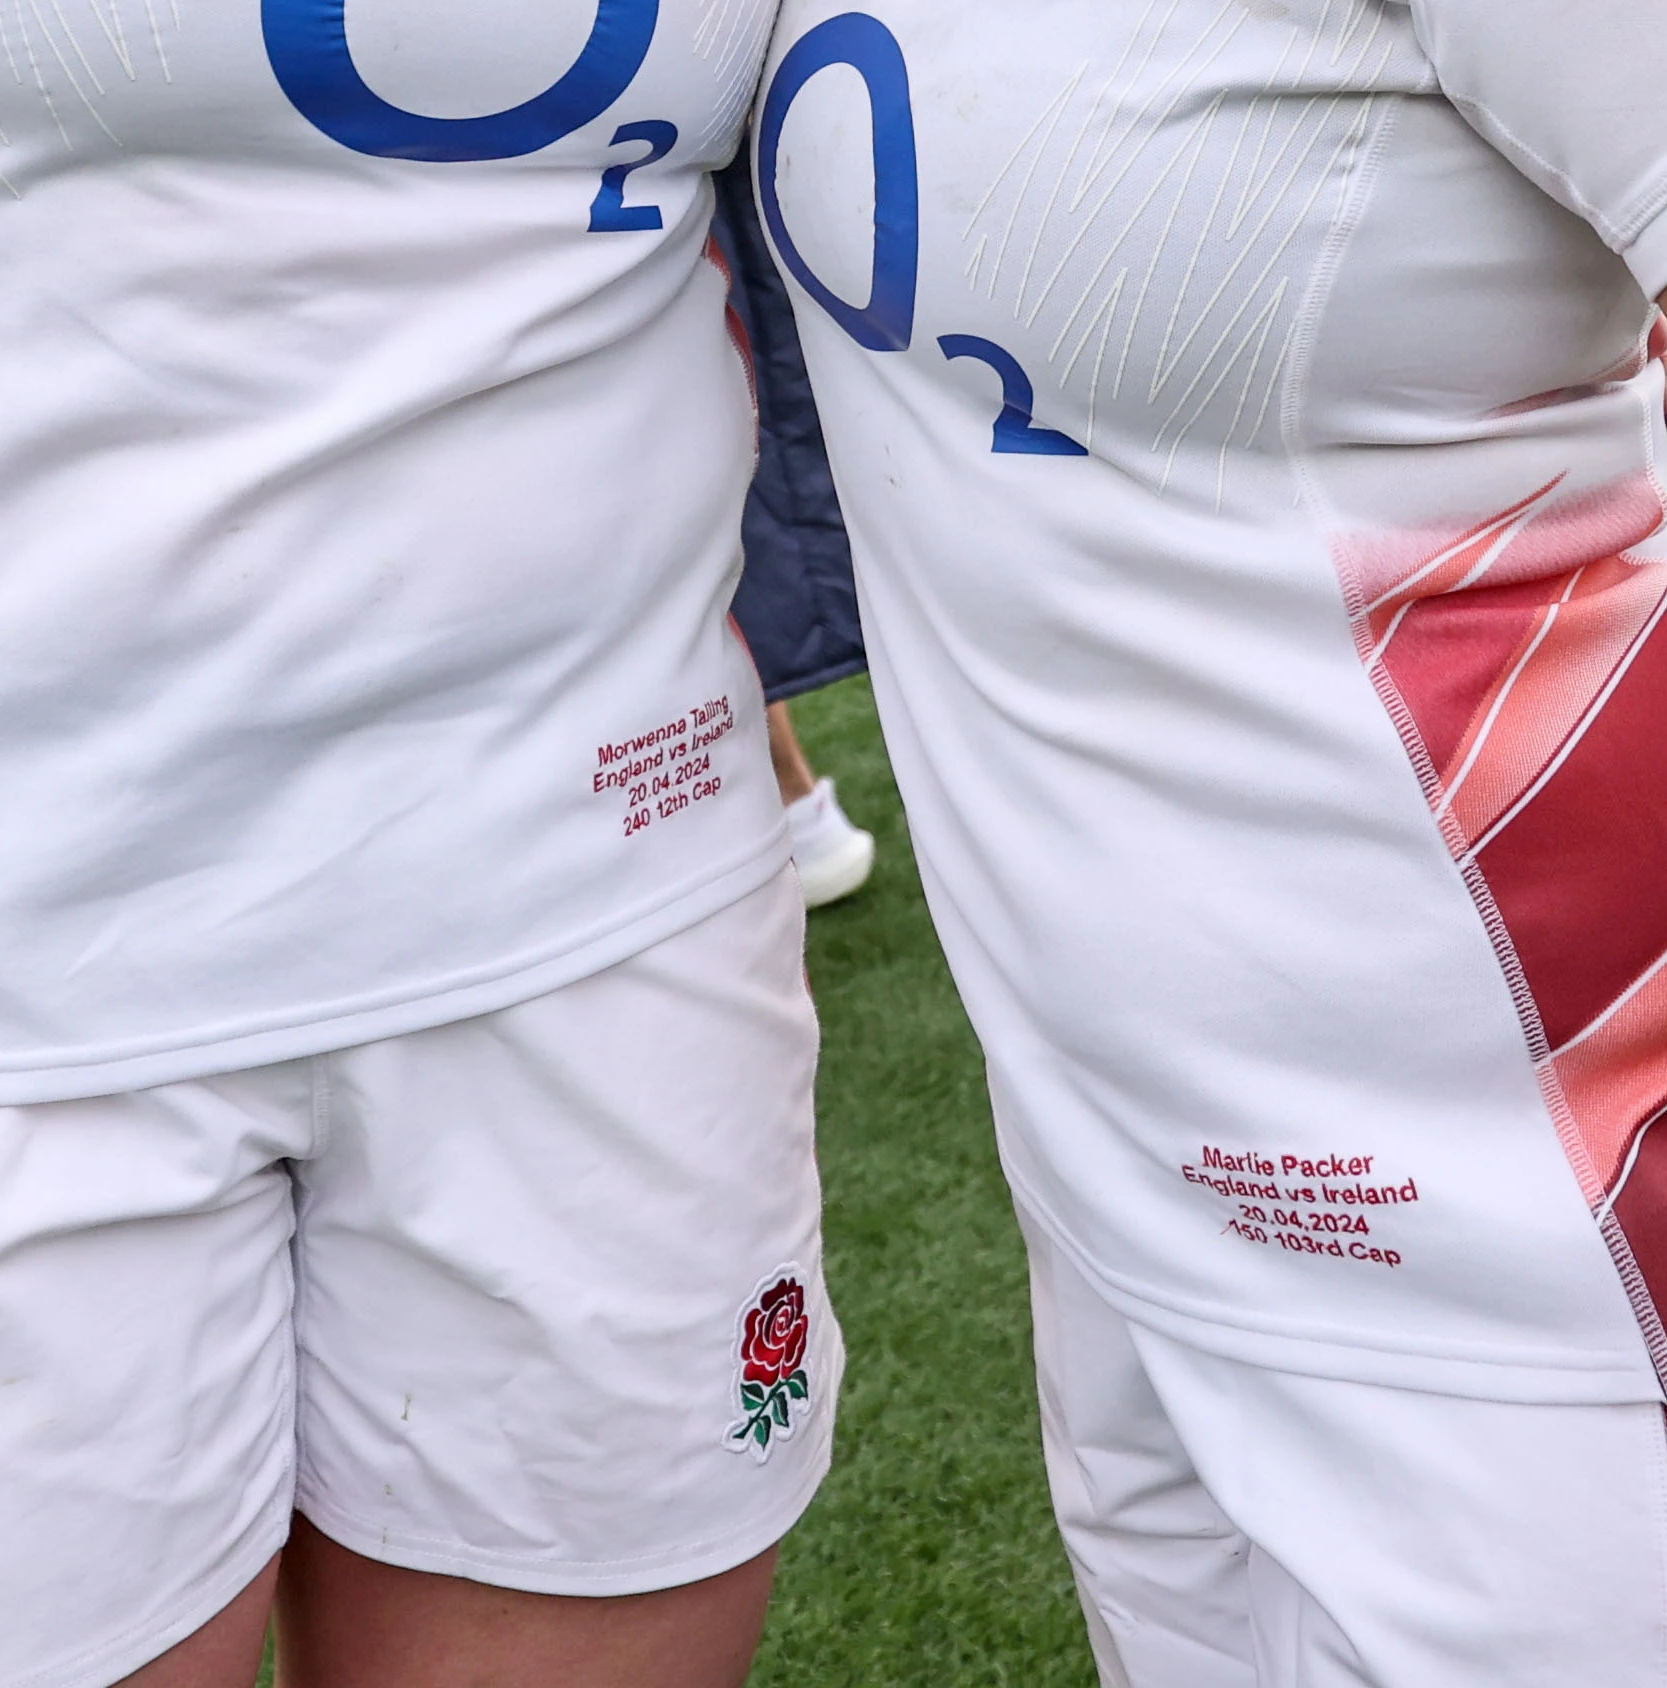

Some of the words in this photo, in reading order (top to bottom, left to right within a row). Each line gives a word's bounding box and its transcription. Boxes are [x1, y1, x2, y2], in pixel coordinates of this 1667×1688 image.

[593, 747, 665, 793] England
[668, 742, 688, 762] vs
[692, 716, 734, 753] Ireland
[597, 718, 687, 767] Morwenna
[690, 694, 733, 729] Talling
[623, 807, 652, 837] 240
[657, 791, 689, 819] 12th
[692, 776, 722, 803] Cap
[628, 752, 711, 808] 20.04.2024
[1182, 1165, 1281, 1200] England
[1285, 1186, 1317, 1203] vs
[1322, 1177, 1419, 1205] Ireland
[1202, 1145, 1275, 1177] Marlie
[1281, 1154, 1374, 1178] Packer
[1229, 1219, 1269, 1244] 150
[1274, 1231, 1345, 1258] 103rd
[1348, 1241, 1403, 1268] Cap
